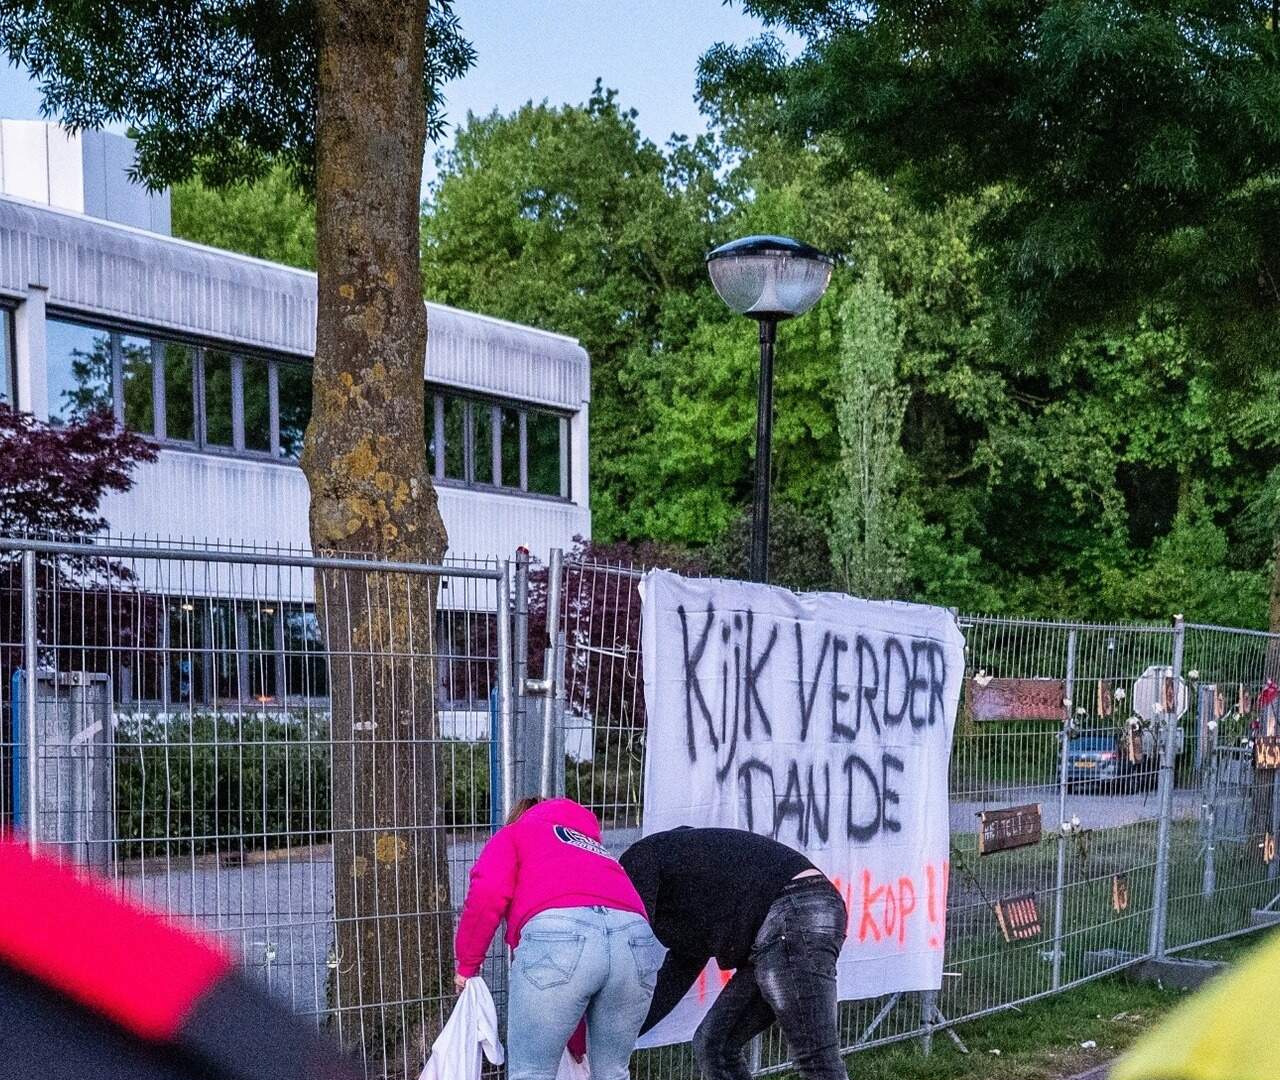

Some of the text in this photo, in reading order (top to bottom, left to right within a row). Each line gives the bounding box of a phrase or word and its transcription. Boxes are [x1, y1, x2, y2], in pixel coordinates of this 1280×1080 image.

[794, 616, 948, 744] VERDER
[738, 752, 905, 847] DAN DE
